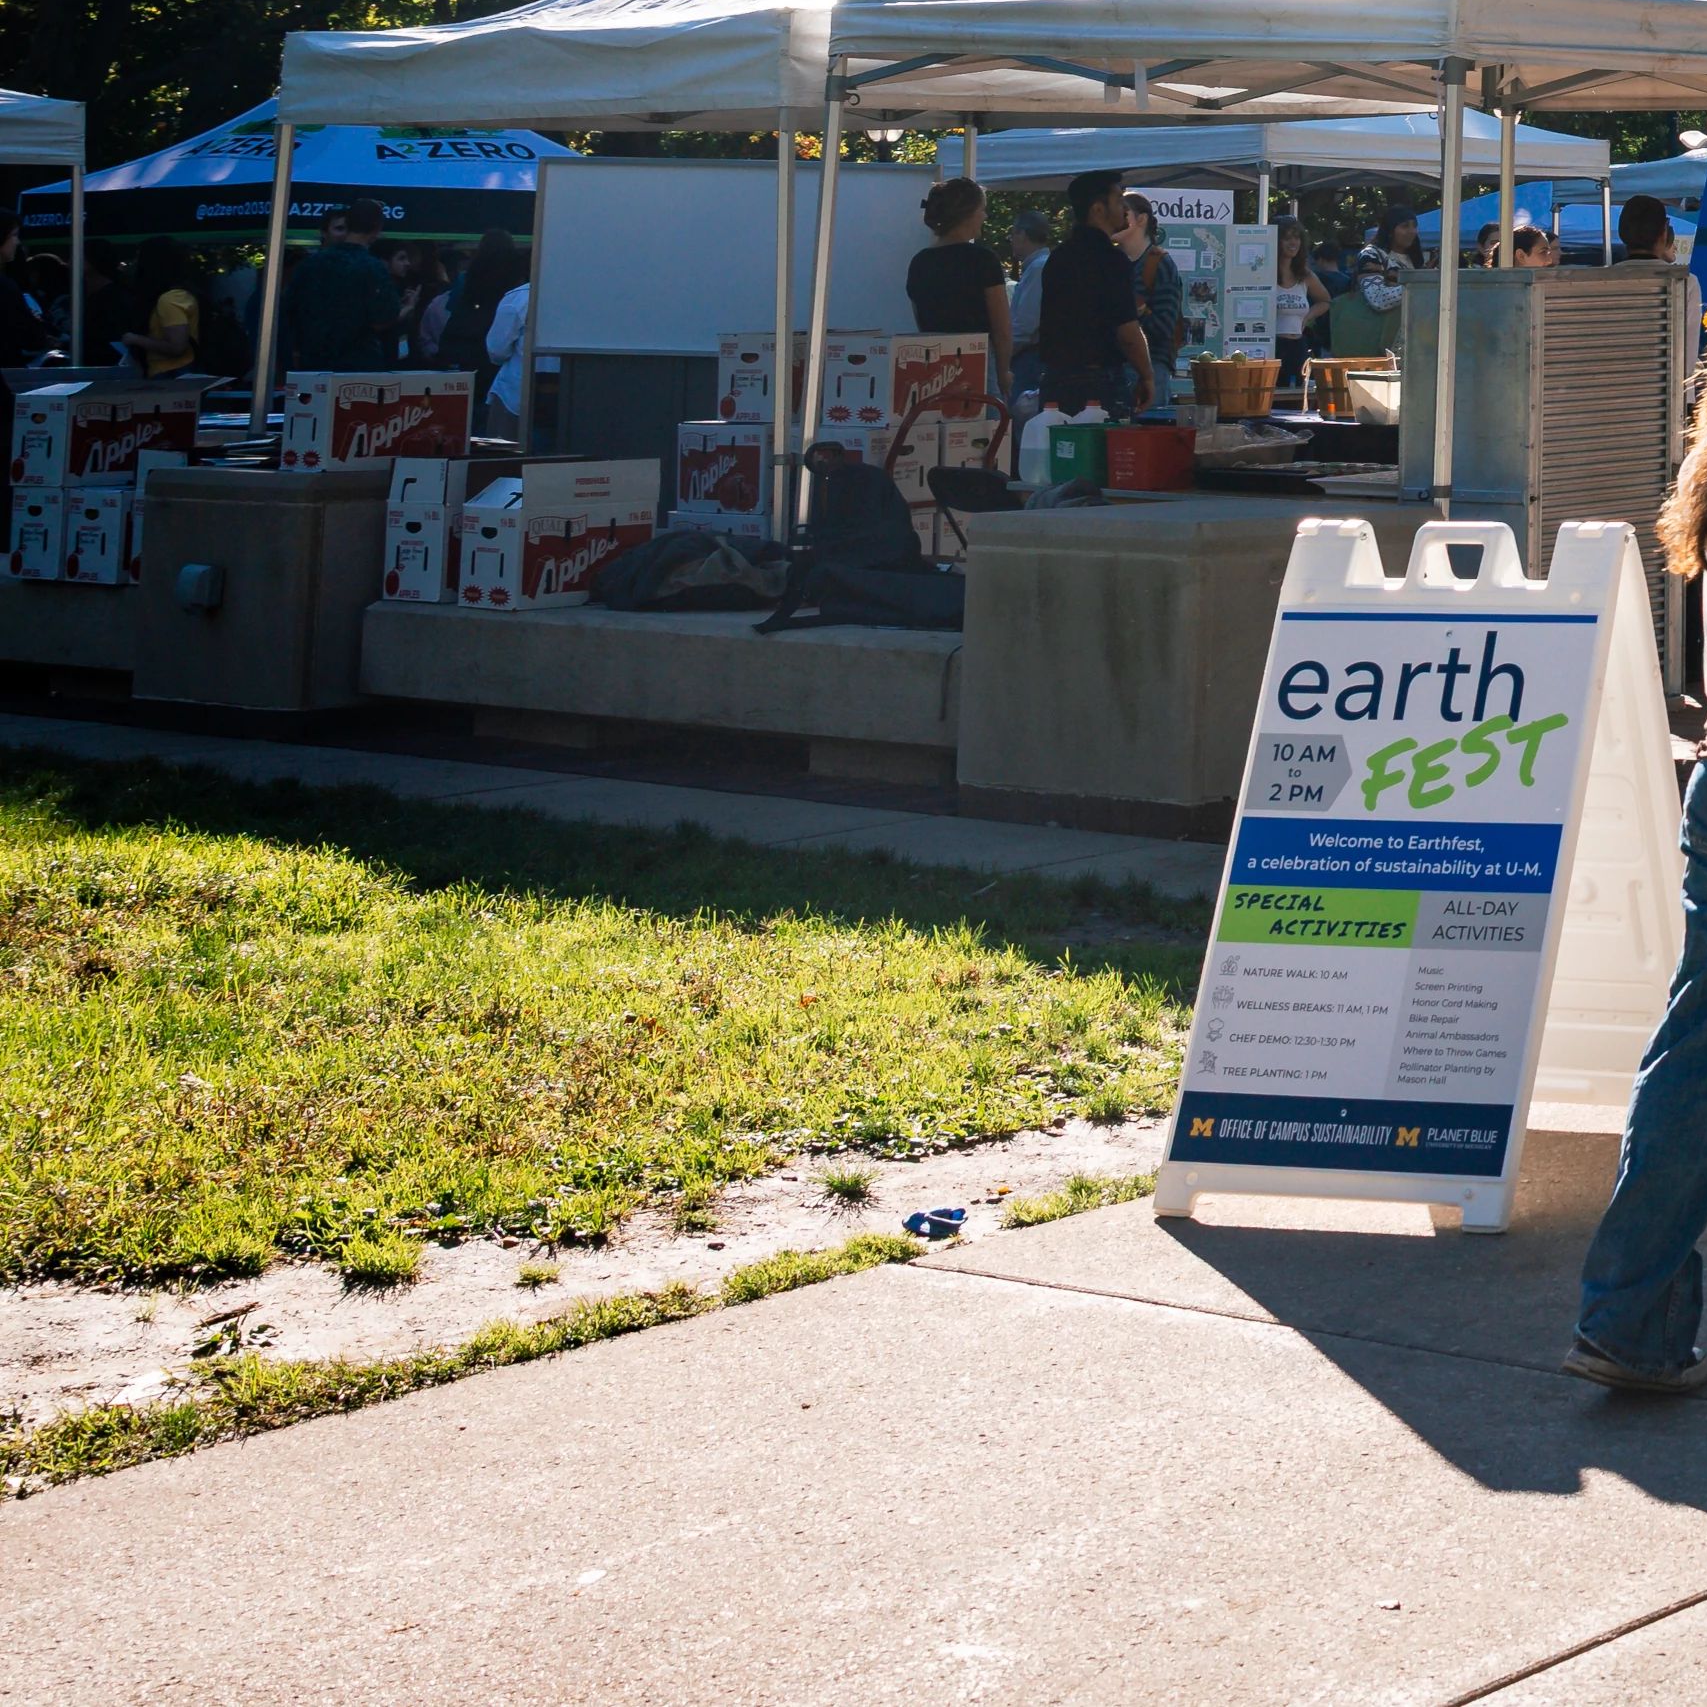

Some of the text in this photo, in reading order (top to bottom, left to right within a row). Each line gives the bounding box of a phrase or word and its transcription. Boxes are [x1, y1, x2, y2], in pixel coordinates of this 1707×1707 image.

[344, 405, 434, 462] Apples
[80, 421, 164, 476] Apples
[688, 453, 738, 502] Apples
[534, 537, 620, 599] Apples
[1277, 631, 1525, 722] earth
[1273, 743, 1336, 763] 10 AM
[1361, 713, 1569, 811] FEST
[1288, 767, 1302, 779] to
[1268, 783, 1323, 802] 2 PM
[1309, 832, 1485, 854] Welcome to Earthfest,
[1247, 856, 1543, 878] a celebration of sustainability at U-M.
[1234, 892, 1325, 912] SPECIAL
[1443, 900, 1520, 916] ALL-DAY
[1269, 919, 1407, 939] ACTIVITIES
[1431, 925, 1526, 942] ACTIVITIES
[1242, 967, 1348, 980] NATURE WALK: 10 AM
[1418, 966, 1445, 975] Music
[1415, 982, 1483, 994] Screen Printing
[1236, 1000, 1290, 1011] WELLNESS
[1292, 1002, 1335, 1013] BREAKS:
[1337, 1004, 1344, 1013] 11
[1345, 1004, 1364, 1015] AM,
[1372, 1005, 1389, 1015] PM
[1412, 998, 1498, 1011] Honor Cord Making
[1409, 1014, 1460, 1025] Bike Repair
[1229, 1033, 1356, 1047] CHEF DEMO: 12:30-1:30 PM
[1405, 1030, 1500, 1042] Animal Ambassadors
[1403, 1046, 1507, 1058] Where to Throw Games
[1222, 1067, 1247, 1077] TREE
[1250, 1068, 1304, 1079] PLANTING:
[1311, 1070, 1328, 1080] PM
[1399, 1062, 1495, 1075] Pollinator Planting by
[1397, 1075, 1447, 1085] Mason Hall
[1190, 1118, 1393, 1146] M OFFICE OF CAMPUS SUSTAINABILITY
[1395, 1127, 1498, 1147] M PLANET BLUE
